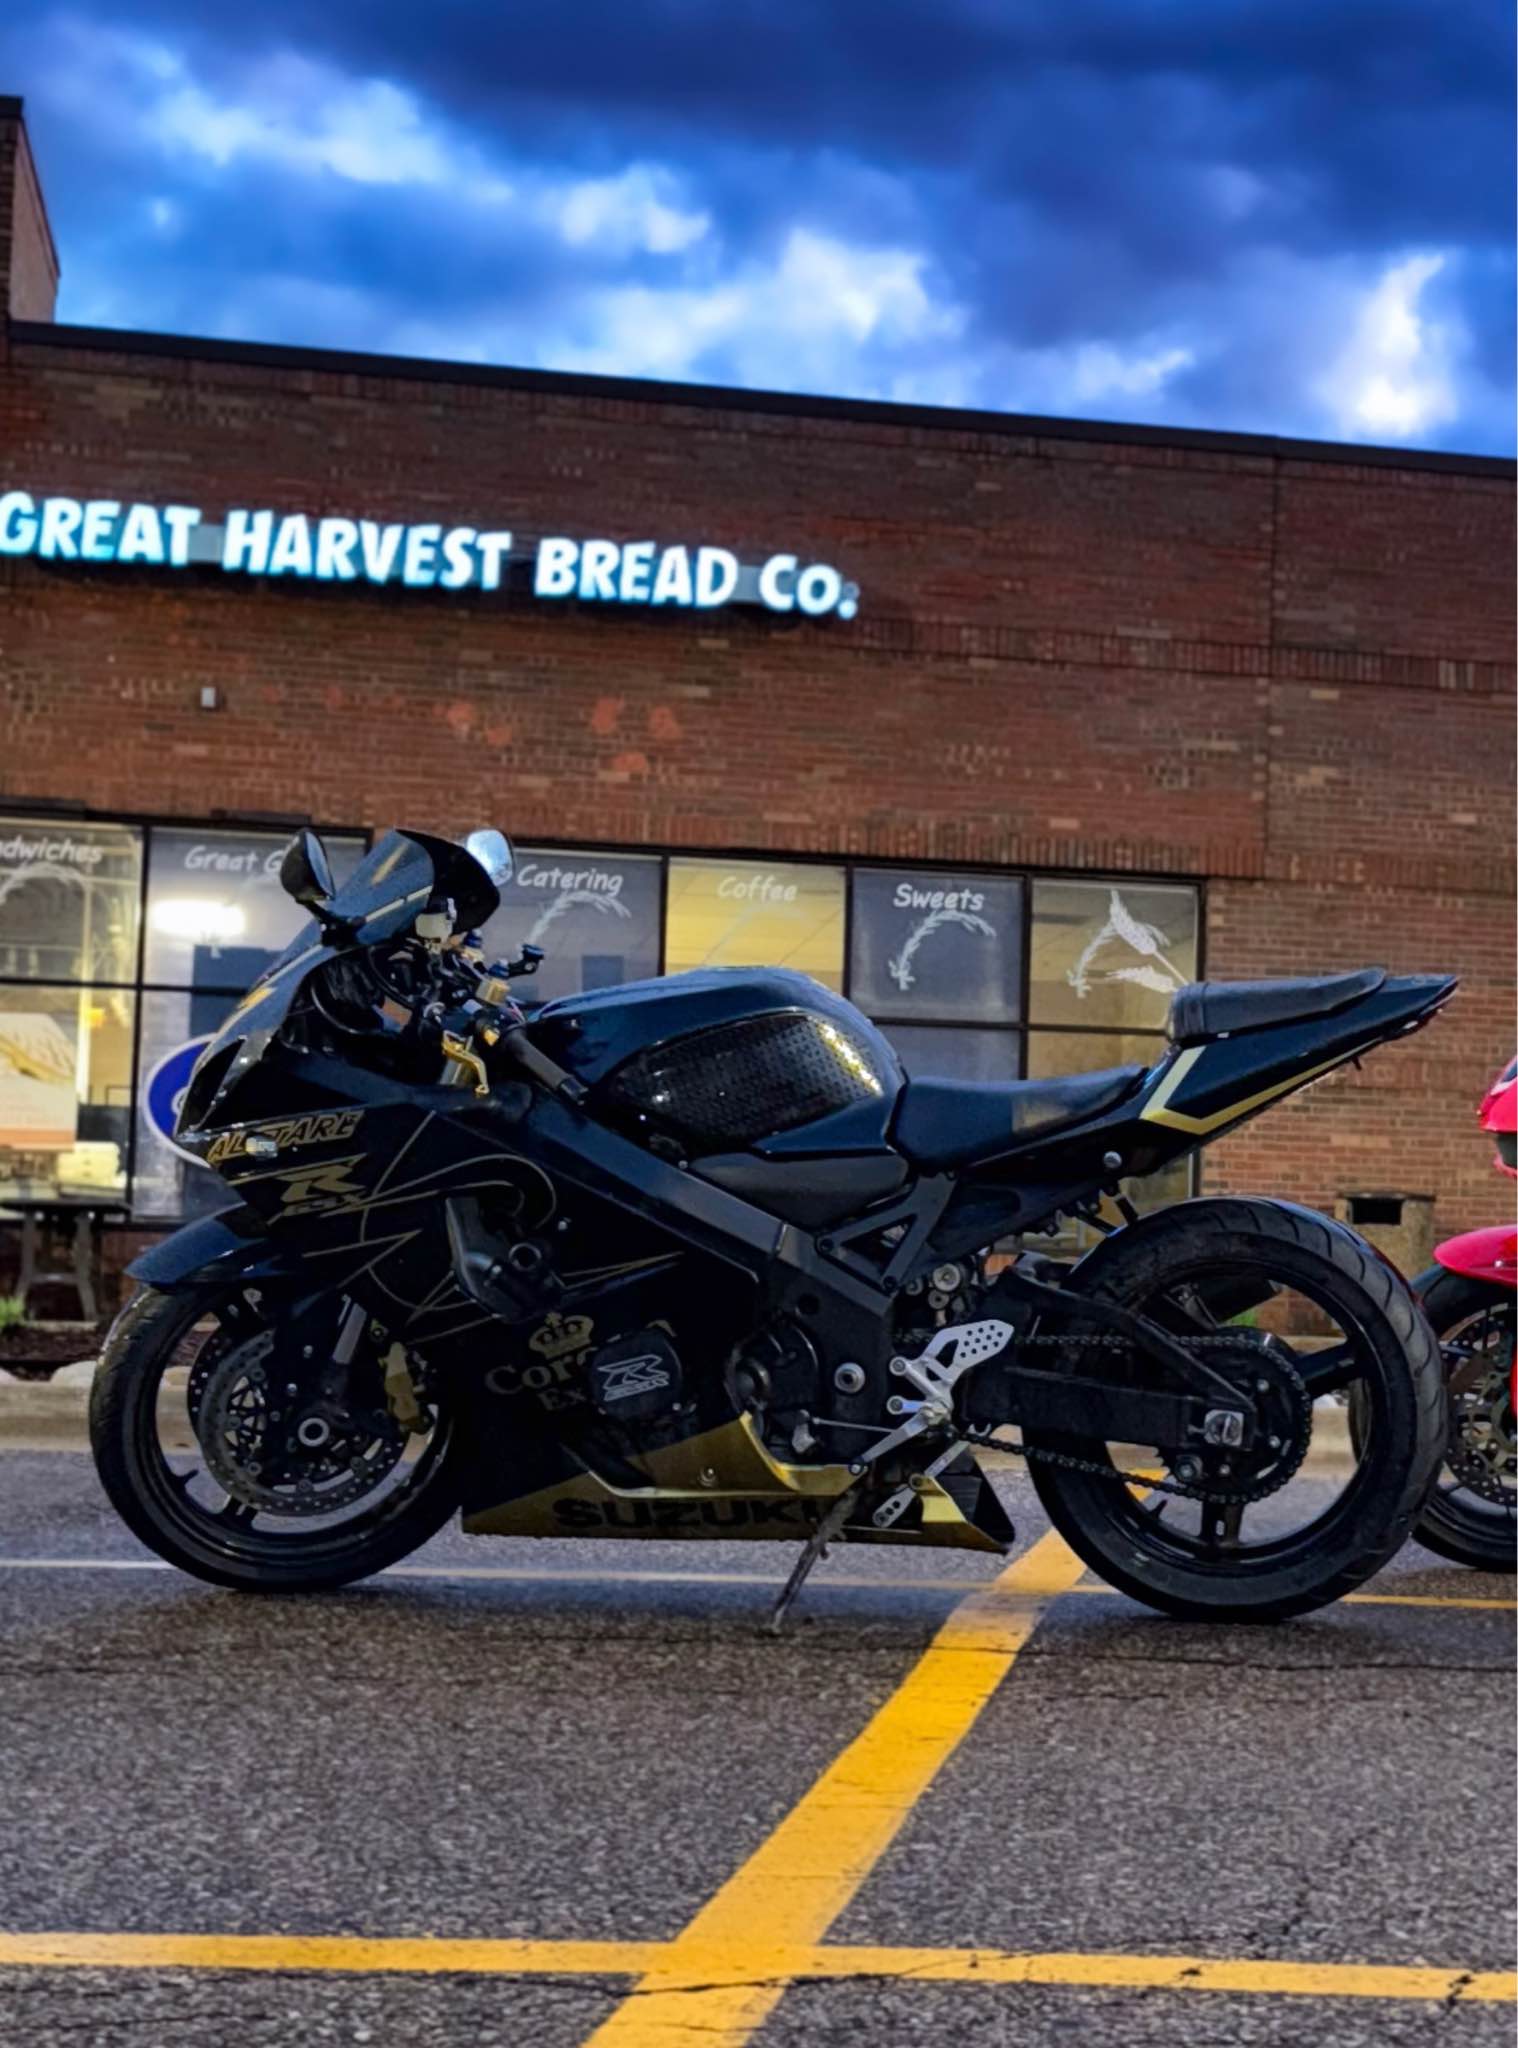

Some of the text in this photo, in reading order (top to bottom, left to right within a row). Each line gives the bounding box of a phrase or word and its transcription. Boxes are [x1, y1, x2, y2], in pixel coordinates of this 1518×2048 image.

[0, 491, 201, 566] GREAT
[223, 510, 511, 590] HARVEST
[534, 538, 737, 608] BREAD
[0, 835, 104, 864] dwiches
[185, 844, 257, 872] Great
[517, 863, 624, 897] Catering
[717, 875, 798, 904] Coffee
[893, 883, 985, 911] Sweets
[208, 1110, 364, 1163] ALTARE
